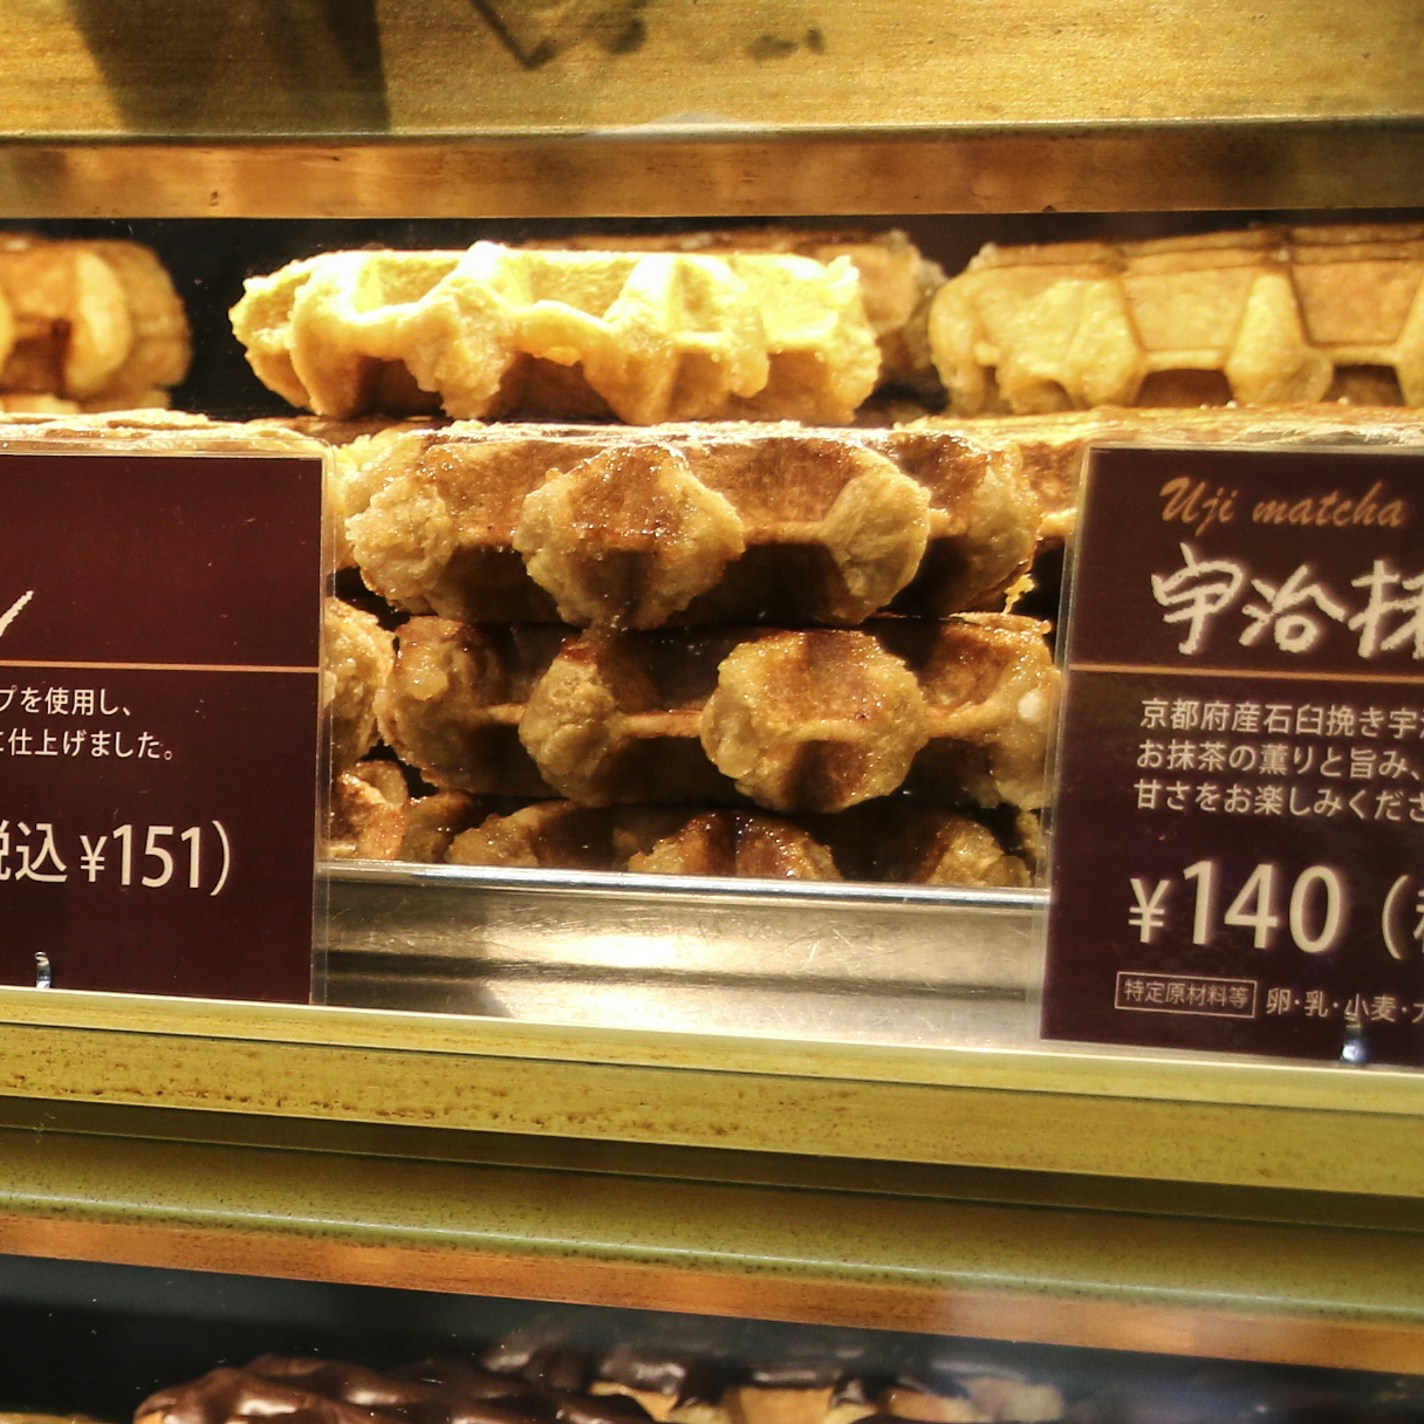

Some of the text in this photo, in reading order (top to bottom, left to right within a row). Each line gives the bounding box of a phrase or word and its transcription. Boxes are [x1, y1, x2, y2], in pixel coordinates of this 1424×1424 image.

[1159, 476, 1406, 536] Uji matcha
[1140, 697, 1424, 739] 京都府産石臼挽き宇
[1136, 739, 1419, 781] お抹茶の薫りと旨み、
[1128, 860, 1341, 953] ¥140
[1123, 979, 1249, 1009] 特定原材料等
